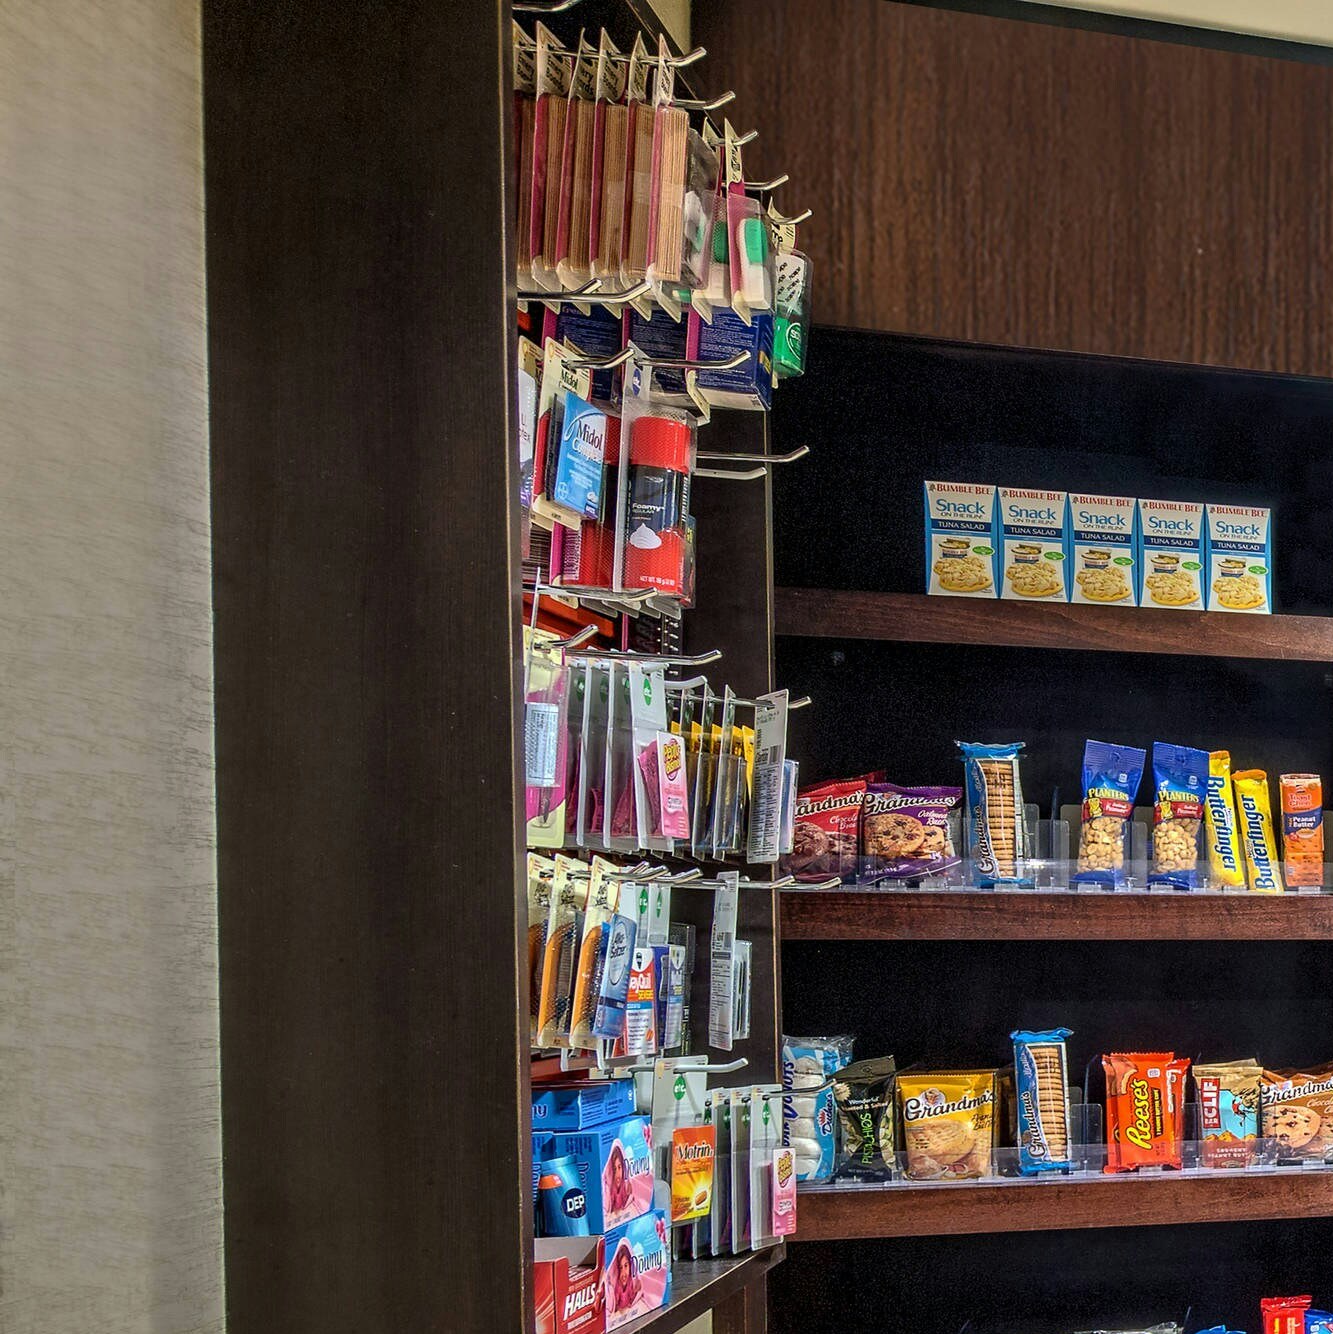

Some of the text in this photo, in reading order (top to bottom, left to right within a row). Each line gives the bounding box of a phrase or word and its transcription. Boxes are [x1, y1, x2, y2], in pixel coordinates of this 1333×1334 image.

[936, 499, 985, 515] Snack
[1009, 504, 1056, 521] Snack
[937, 520, 985, 532] TUNA SALAD
[1079, 511, 1126, 527] Snack
[1148, 516, 1194, 532] Snack
[1011, 527, 1056, 537] TUNA SALAD
[1216, 520, 1260, 537] Snack
[1081, 532, 1125, 543] TUNA SALAD
[1150, 538, 1193, 548] TUNA SALAD
[1218, 542, 1260, 552] TUNA SALAD
[1208, 775, 1237, 873] Butterfinger
[1241, 794, 1276, 892] Butterfinger
[1203, 1081, 1219, 1119] CLIF
[566, 1195, 585, 1213] DEP
[564, 1283, 597, 1321] HALLS
